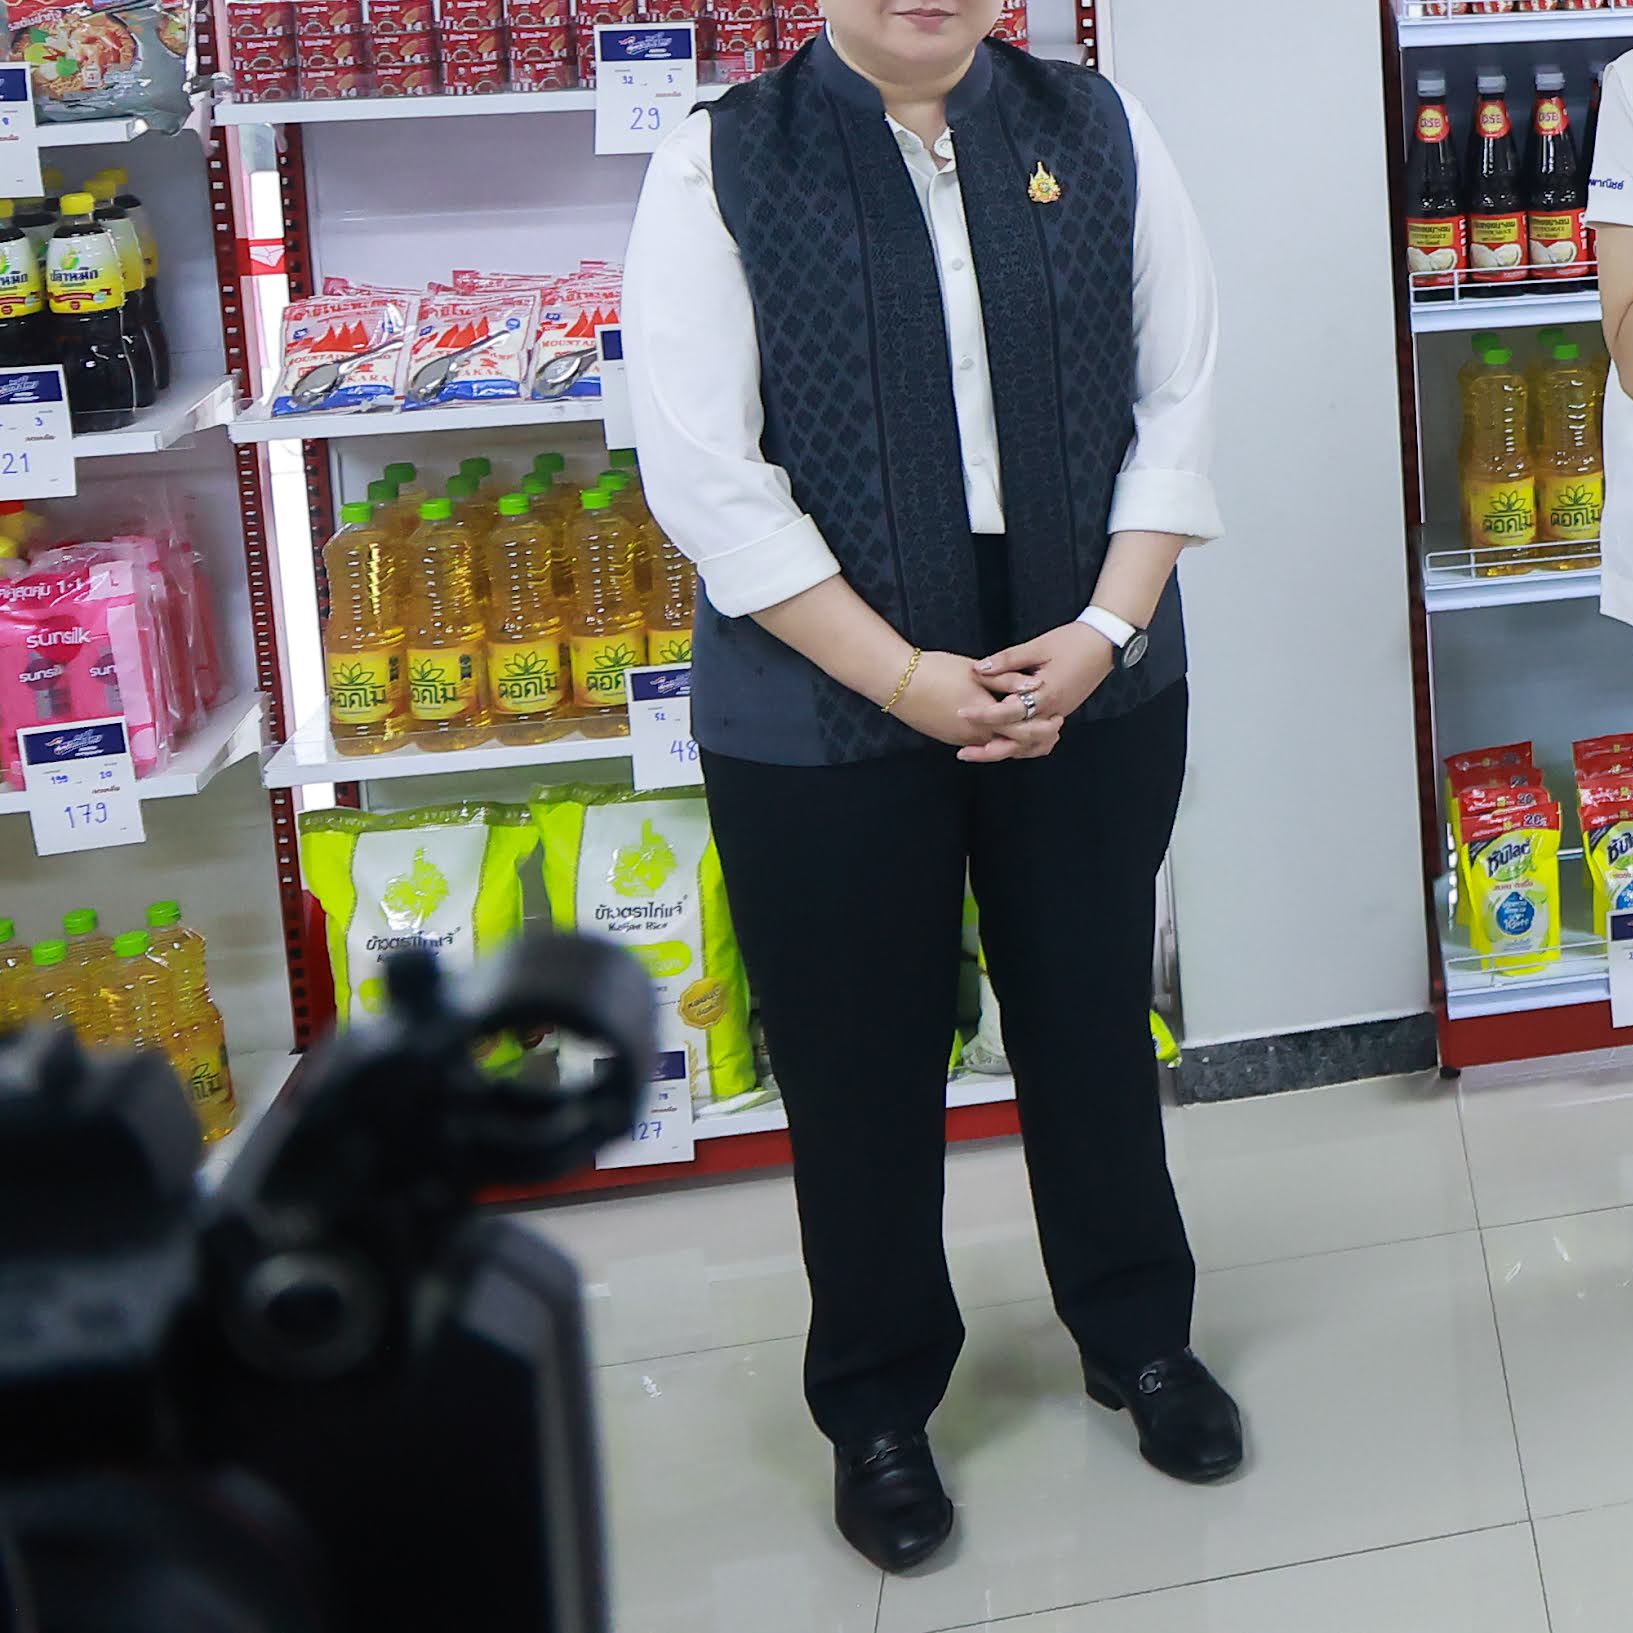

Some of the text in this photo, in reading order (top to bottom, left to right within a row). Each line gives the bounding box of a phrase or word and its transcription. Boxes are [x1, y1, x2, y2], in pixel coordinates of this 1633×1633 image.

[630, 107, 661, 131] 29
[50, 267, 99, 282] ปลาหมึก
[2, 452, 30, 474] 21
[26, 625, 91, 650] sunsilk
[669, 739, 698, 765] 48
[64, 801, 108, 829] 179
